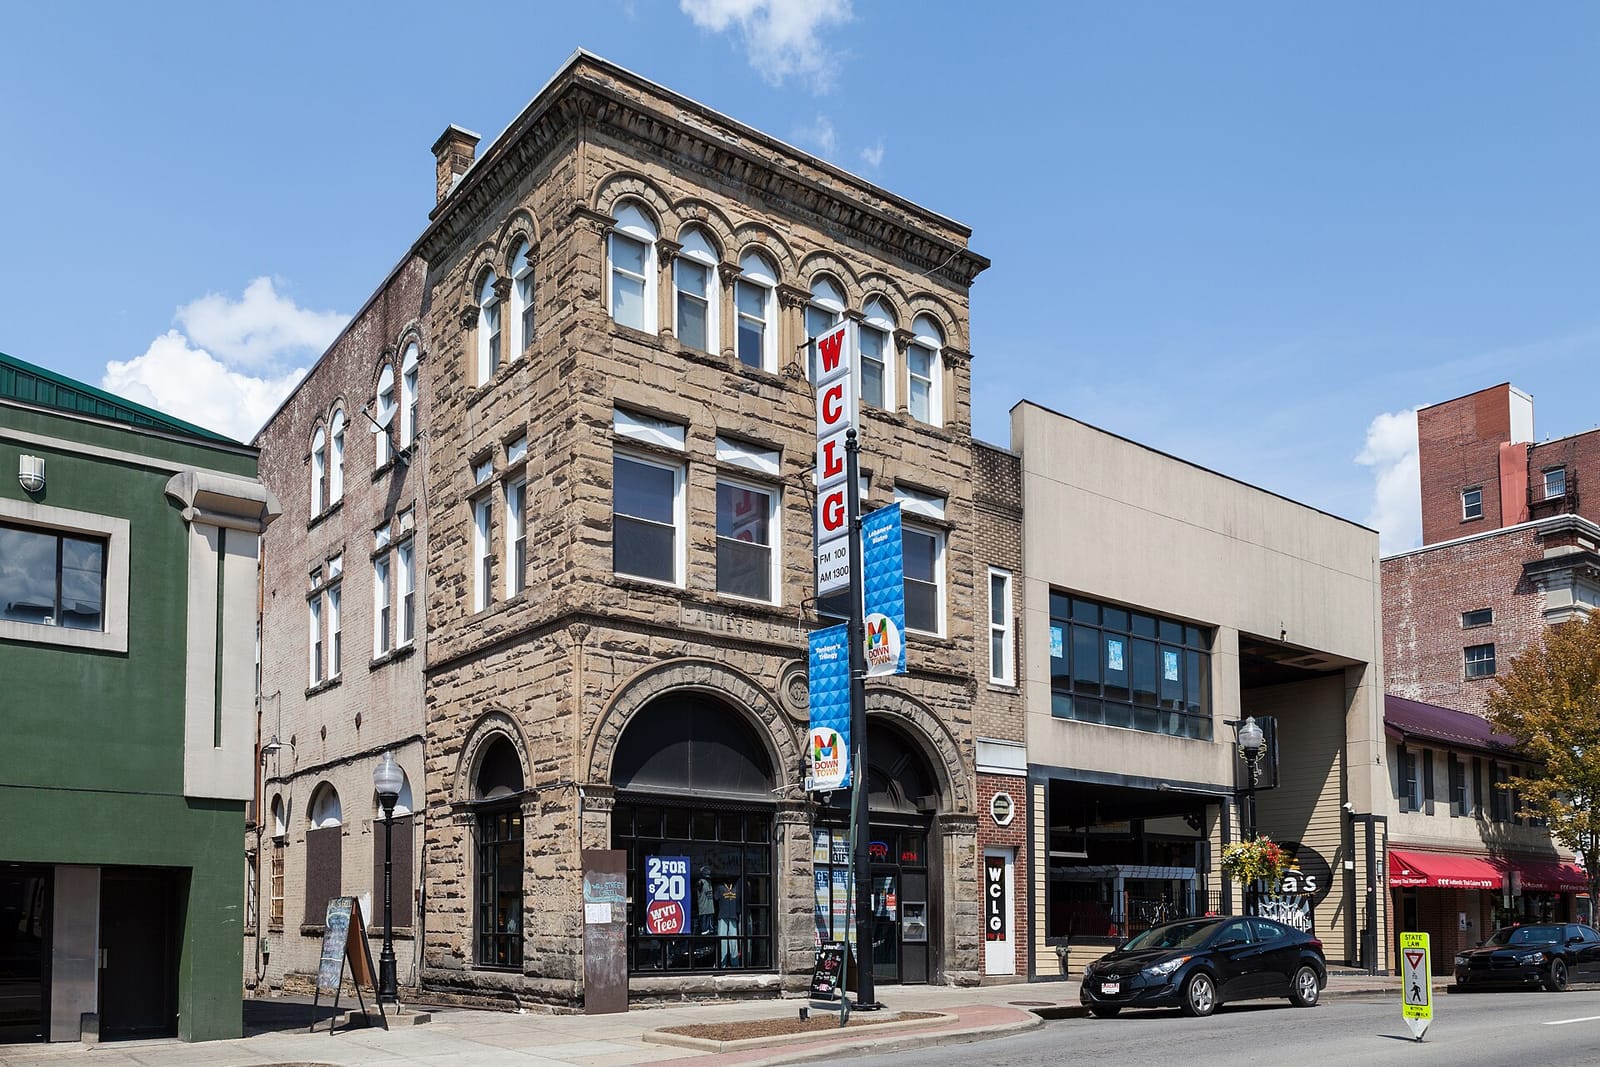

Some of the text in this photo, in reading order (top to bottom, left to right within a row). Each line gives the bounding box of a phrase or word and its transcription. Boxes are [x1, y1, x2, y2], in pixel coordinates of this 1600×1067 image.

[818, 328, 845, 532] WCLG
[819, 547, 847, 565] FM 100
[819, 565, 850, 583] AM 1300
[868, 646, 889, 658] DOWN
[870, 655, 890, 666] TOWN
[815, 760, 838, 769] DOWN
[816, 768, 838, 776] TOWN
[649, 858, 686, 878] 2 FOR
[988, 867, 1002, 931] WCLG
[650, 904, 676, 921] WVU
[654, 918, 677, 933] Tees
